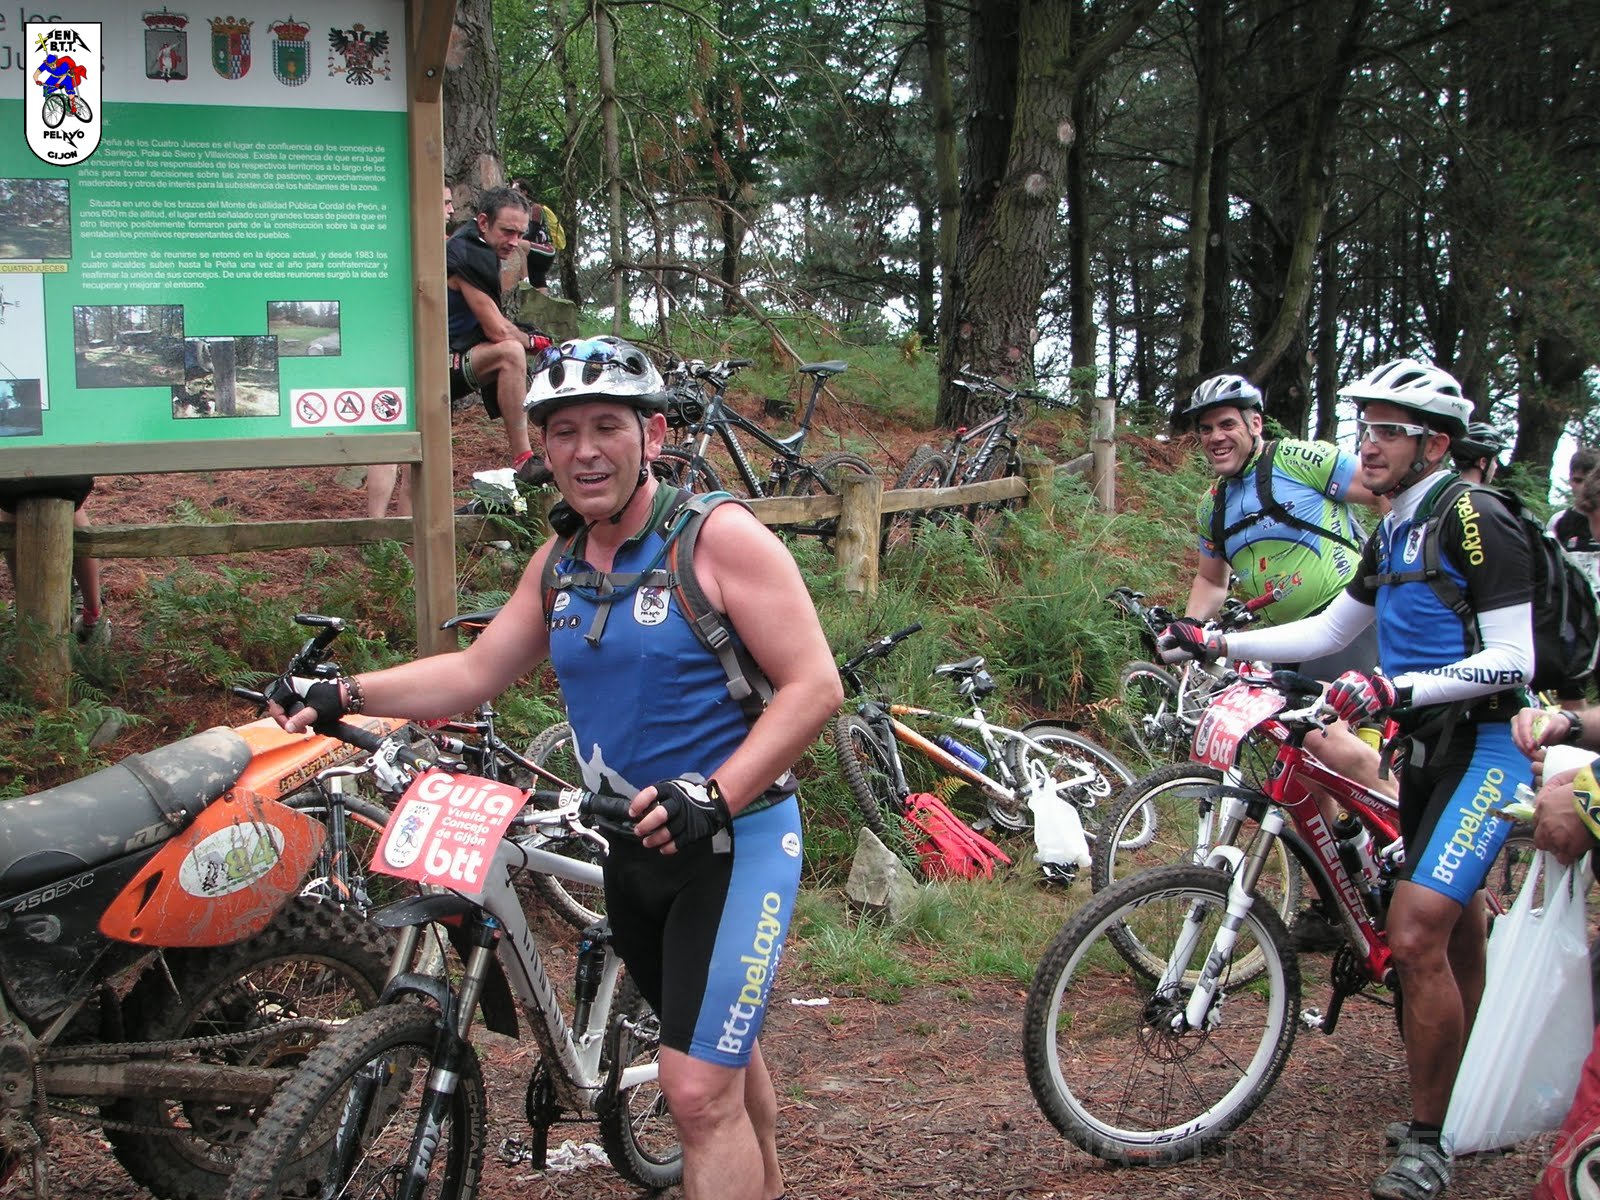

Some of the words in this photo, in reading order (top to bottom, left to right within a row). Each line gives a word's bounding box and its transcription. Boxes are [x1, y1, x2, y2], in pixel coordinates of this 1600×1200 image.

[416, 773, 514, 817] Guía
[447, 806, 488, 824] Vuelta
[436, 828, 452, 840] de
[454, 829, 486, 847] Gijón
[441, 816, 490, 836] Concejo
[424, 838, 484, 884] btt
[1306, 813, 1366, 924] MERIDA
[14, 873, 94, 912] 450EXC
[1199, 943, 1232, 994] FOX
[413, 1112, 446, 1180] FOX
